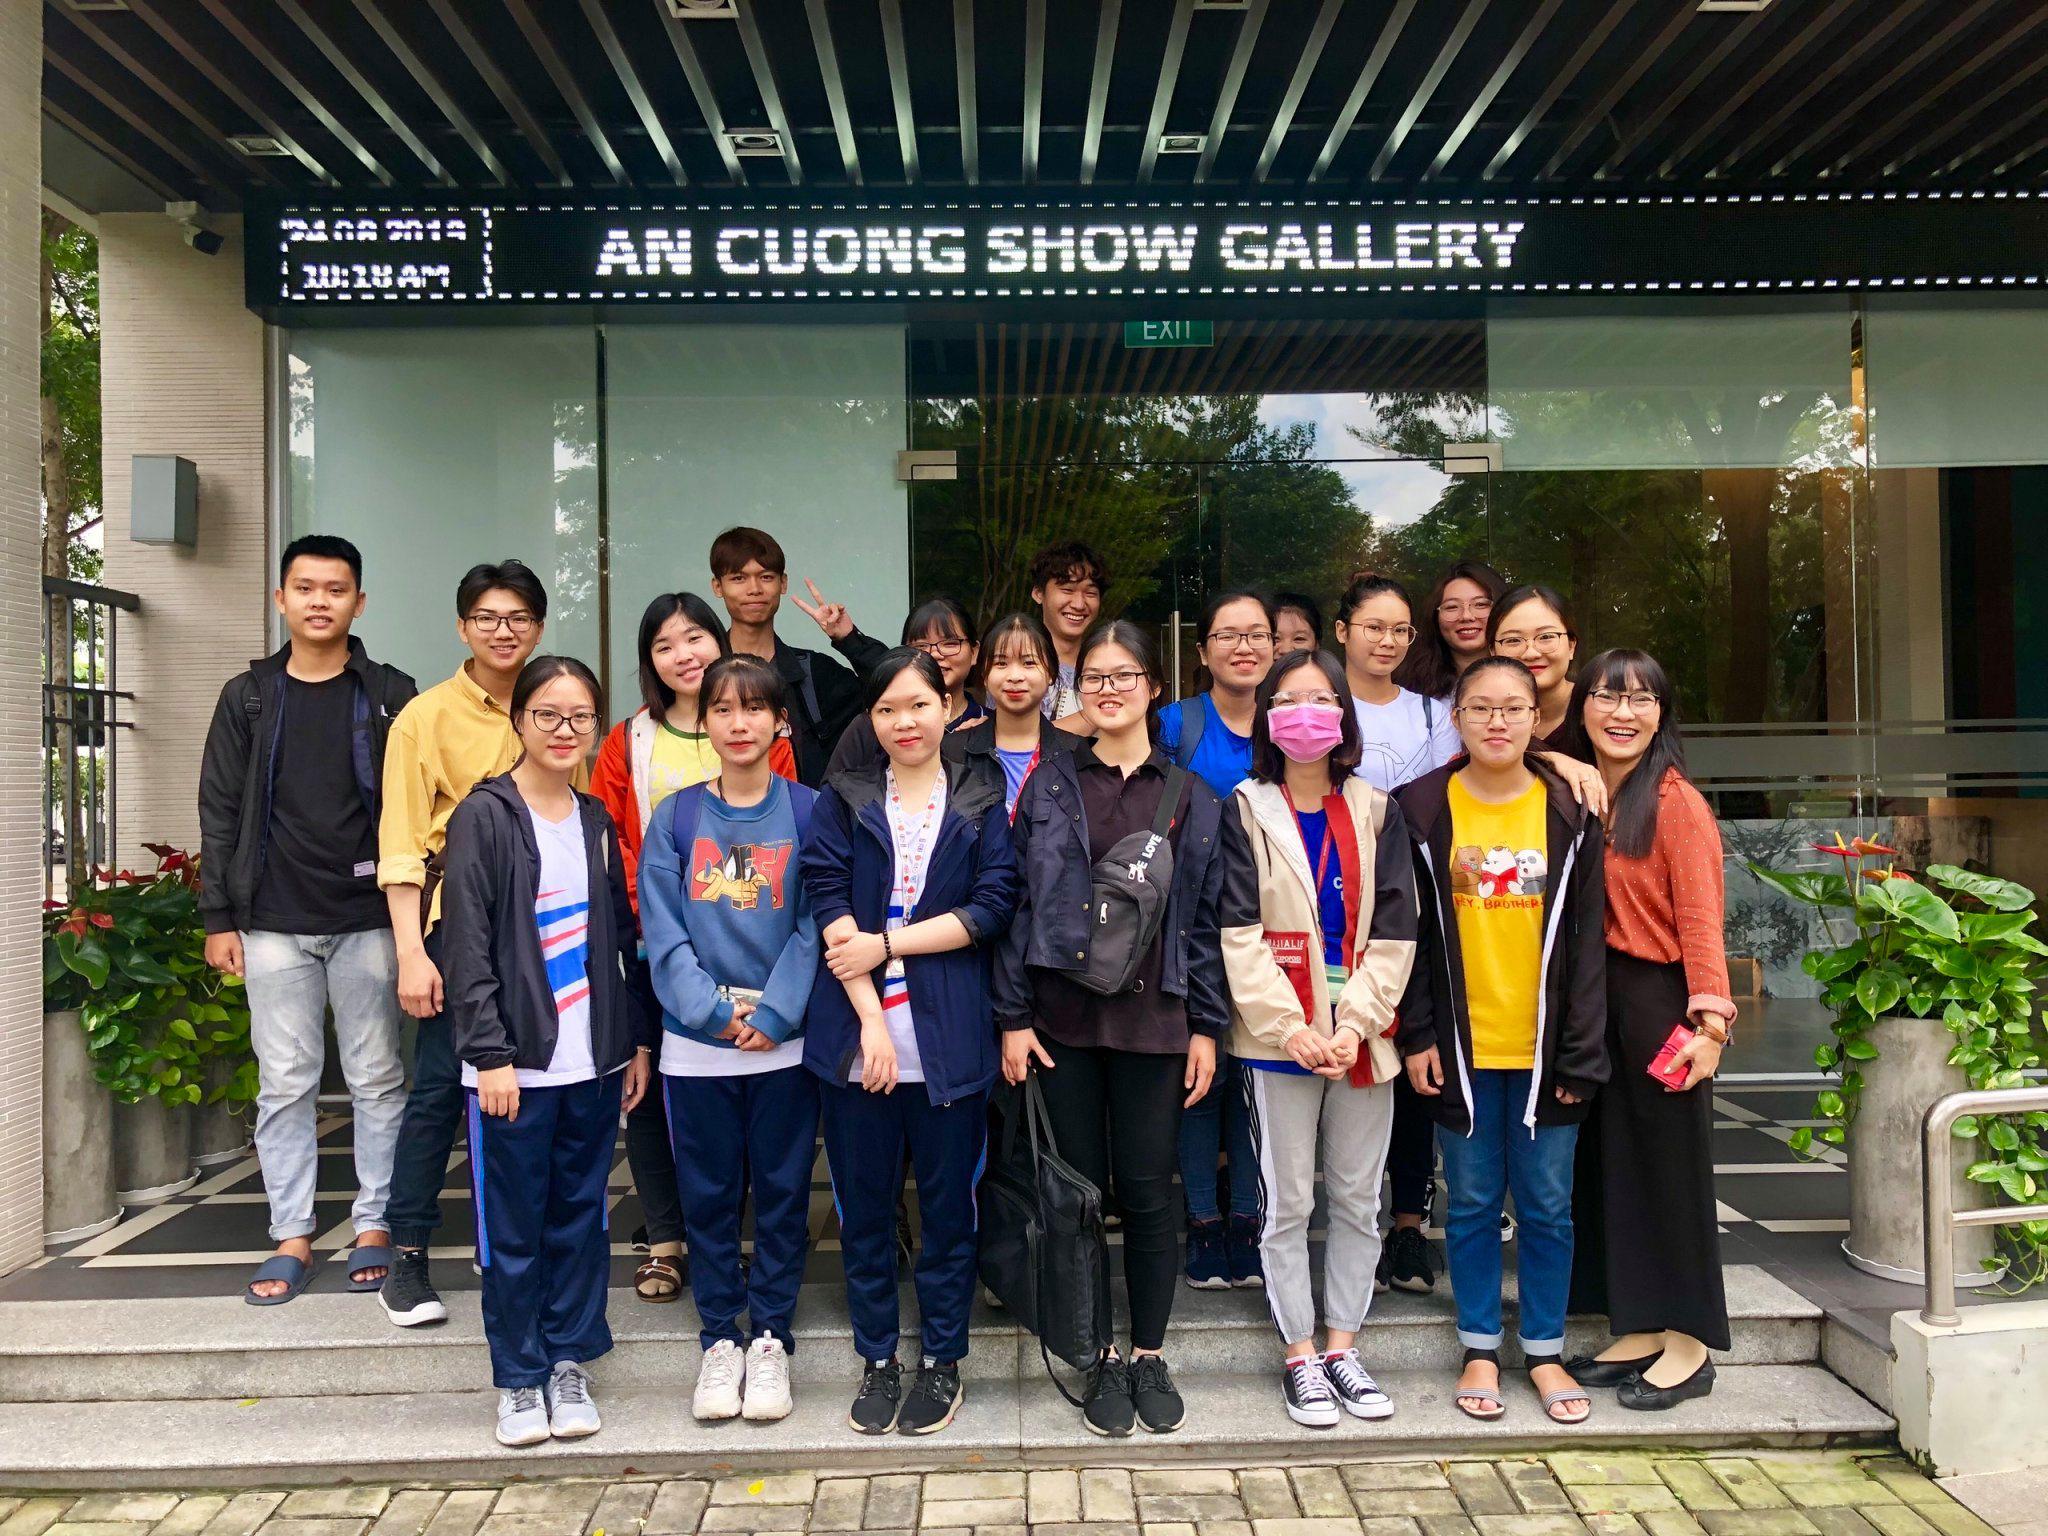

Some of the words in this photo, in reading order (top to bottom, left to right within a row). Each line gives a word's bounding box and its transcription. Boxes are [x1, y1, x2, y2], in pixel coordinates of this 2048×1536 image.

[595, 229, 693, 276] AN
[716, 227, 966, 275] CUONG
[986, 225, 1199, 273] SHOW
[1218, 222, 1525, 271] GALLERY
[1143, 320, 1190, 340] EXIT
[1141, 833, 1163, 859] LOVE
